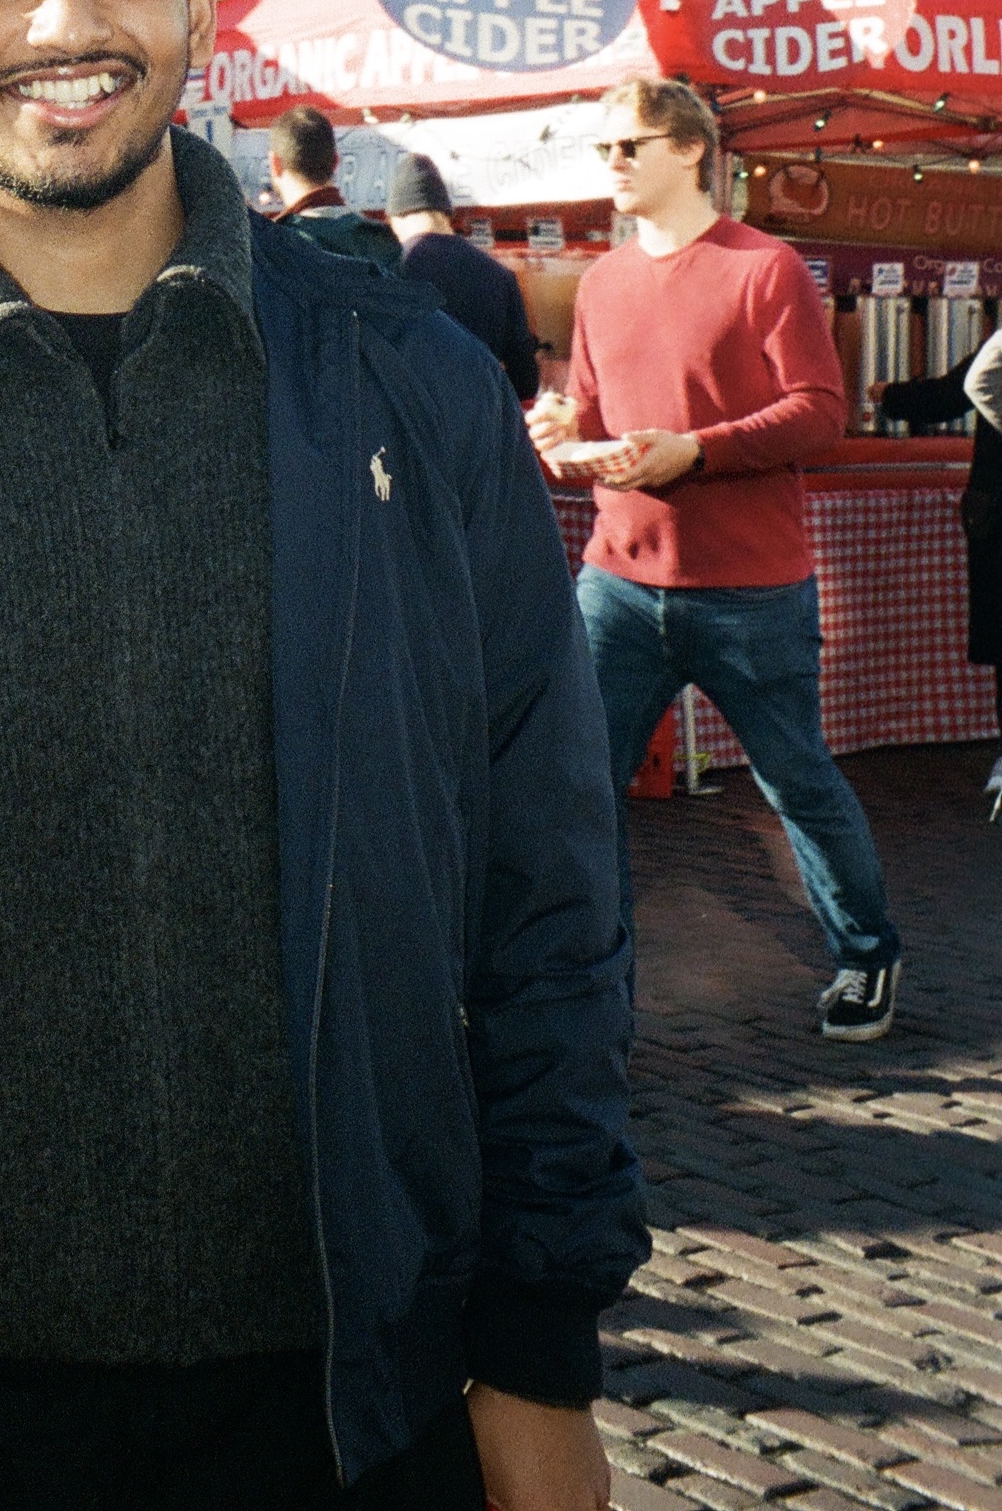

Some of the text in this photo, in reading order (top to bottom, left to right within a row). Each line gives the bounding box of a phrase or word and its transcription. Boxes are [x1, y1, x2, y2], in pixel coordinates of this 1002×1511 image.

[403, 3, 603, 65] CIDER
[711, 16, 890, 76] CIDER
[894, 13, 1002, 75] ORL
[208, 32, 357, 103] ORGANIC
[848, 195, 912, 231] HOT
